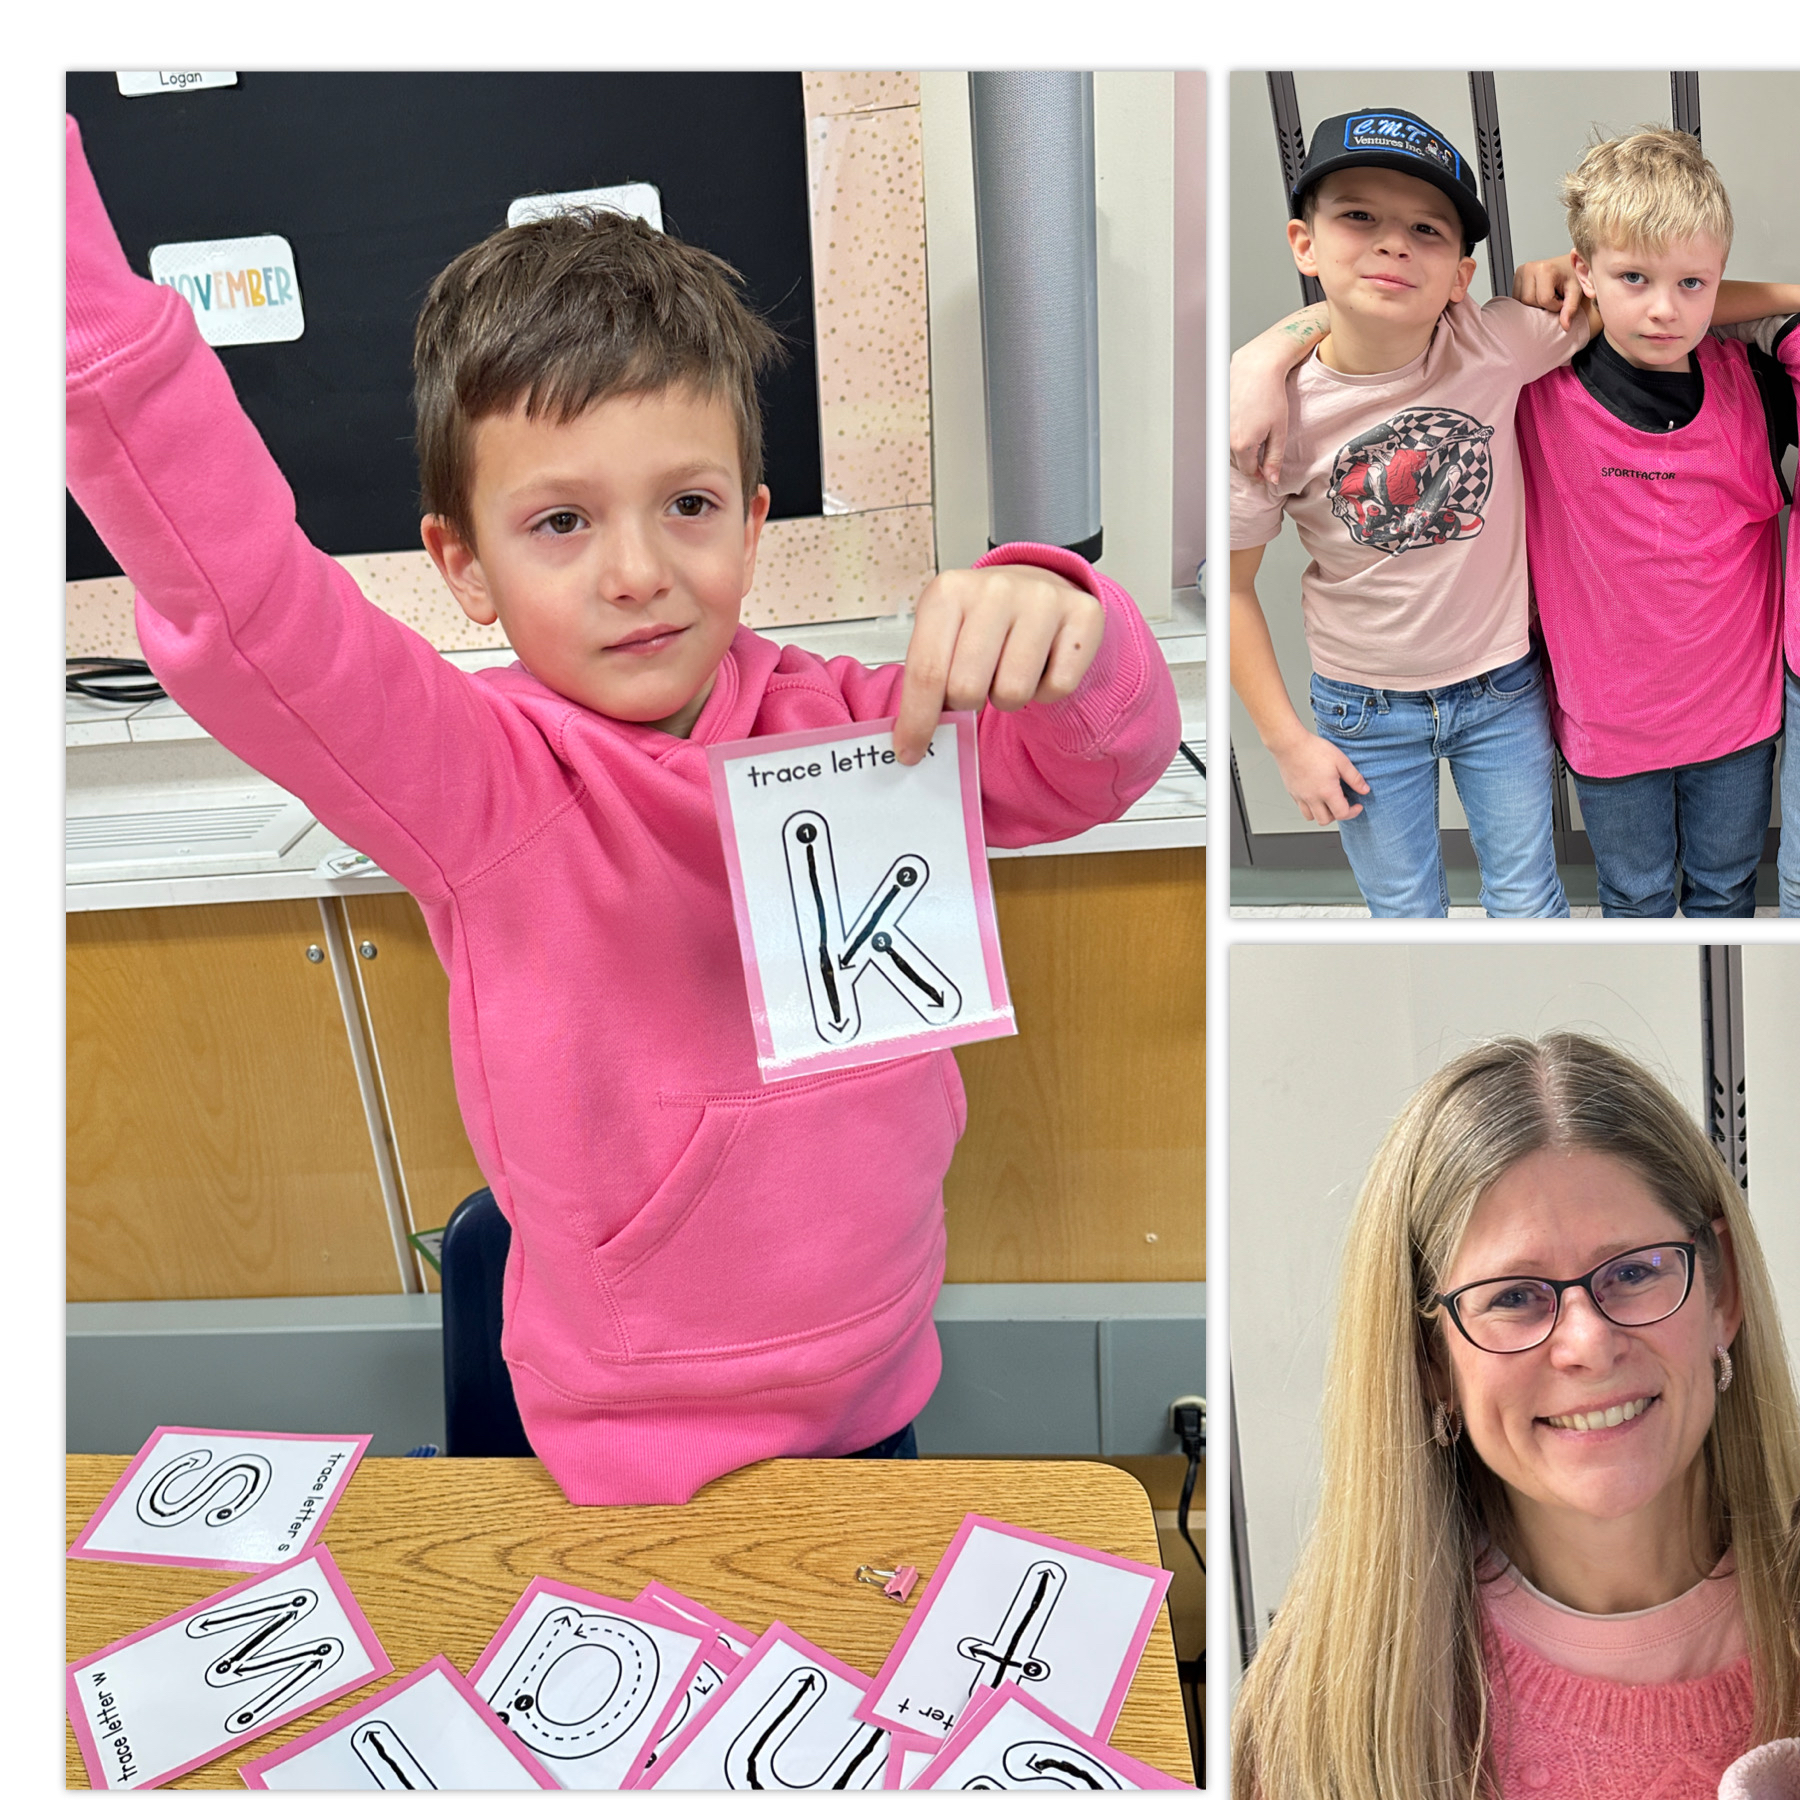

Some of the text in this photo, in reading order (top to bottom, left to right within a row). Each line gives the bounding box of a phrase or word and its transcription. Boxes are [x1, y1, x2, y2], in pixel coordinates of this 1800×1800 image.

[159, 71, 203, 88] Logan
[1354, 136, 1403, 148] Ventures
[1601, 467, 1676, 481] SPORTFACTOR
[747, 763, 821, 788] trace
[831, 745, 896, 773] lette
[312, 1453, 345, 1491] trace
[288, 1496, 324, 1539] letter
[97, 1690, 124, 1740] letter
[114, 1735, 138, 1783] trace
